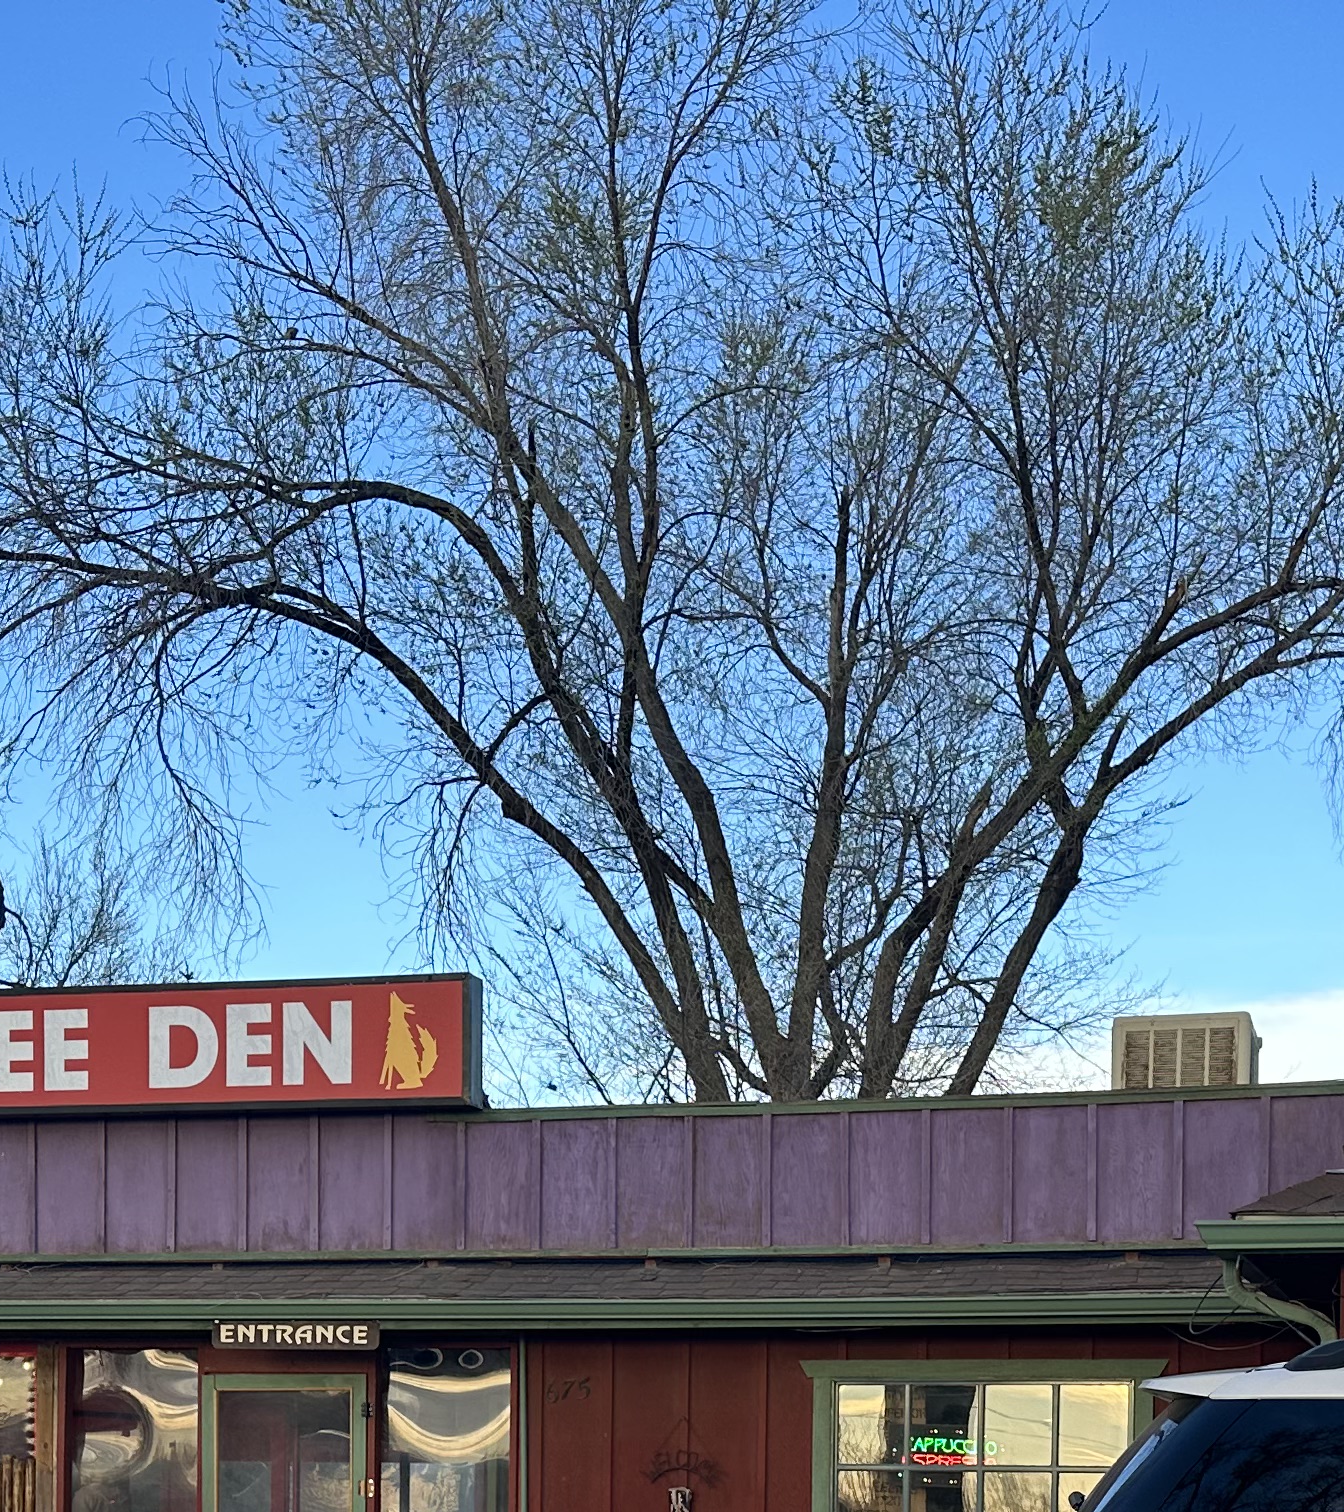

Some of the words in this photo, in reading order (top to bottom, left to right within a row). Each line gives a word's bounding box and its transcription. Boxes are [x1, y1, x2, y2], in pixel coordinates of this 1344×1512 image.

[147, 1000, 353, 1089] DEN
[219, 1323, 369, 1346] ENTRANCE
[546, 1376, 591, 1404] 675
